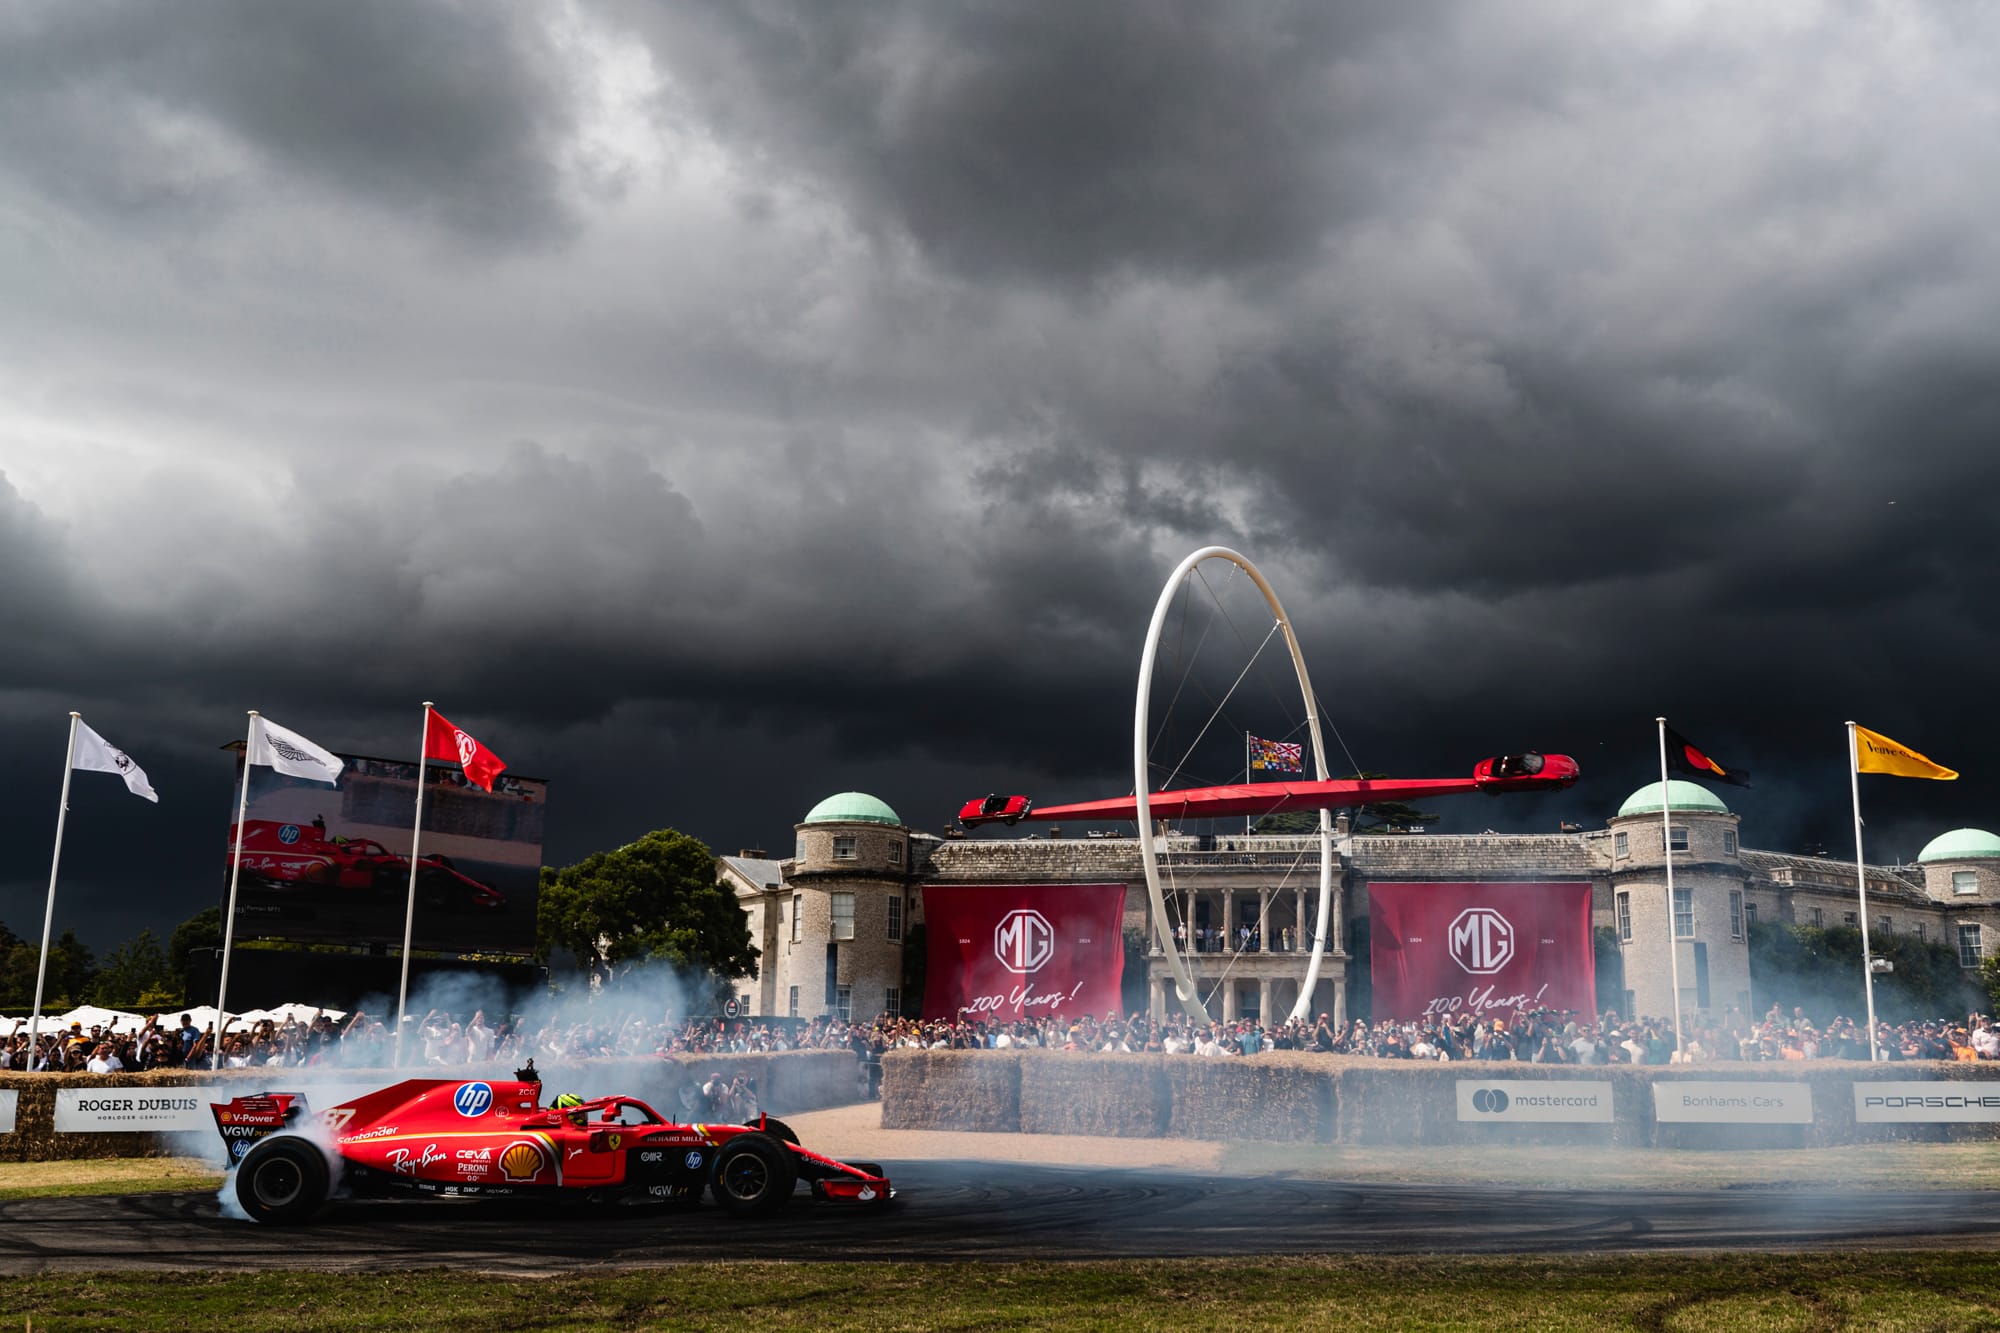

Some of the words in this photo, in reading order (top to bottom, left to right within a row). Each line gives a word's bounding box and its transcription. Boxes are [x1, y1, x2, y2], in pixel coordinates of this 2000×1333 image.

[281, 825, 299, 844] hp
[1001, 915, 1048, 967] MG
[1454, 914, 1508, 968] MG
[967, 994, 1005, 1014] 100
[1422, 996, 1463, 1015] 100
[458, 1082, 490, 1117] hp
[518, 1088, 536, 1096] ZCG
[78, 1099, 134, 1112] ROGER
[138, 1098, 198, 1111] DUBUIS
[1515, 1095, 1598, 1107] mastercard
[1682, 1095, 1748, 1108] Bonhams
[1752, 1096, 1784, 1108] Cars
[1865, 1096, 2000, 1108] PORSCHE
[232, 1113, 275, 1123] V-Power
[324, 1108, 357, 1131] 87
[222, 1126, 255, 1137] VGW
[336, 1125, 399, 1145] Santander
[234, 1140, 249, 1157] hp
[457, 1162, 488, 1173] PERONI
[687, 1152, 701, 1169] hp
[648, 1184, 673, 1196] VGW
